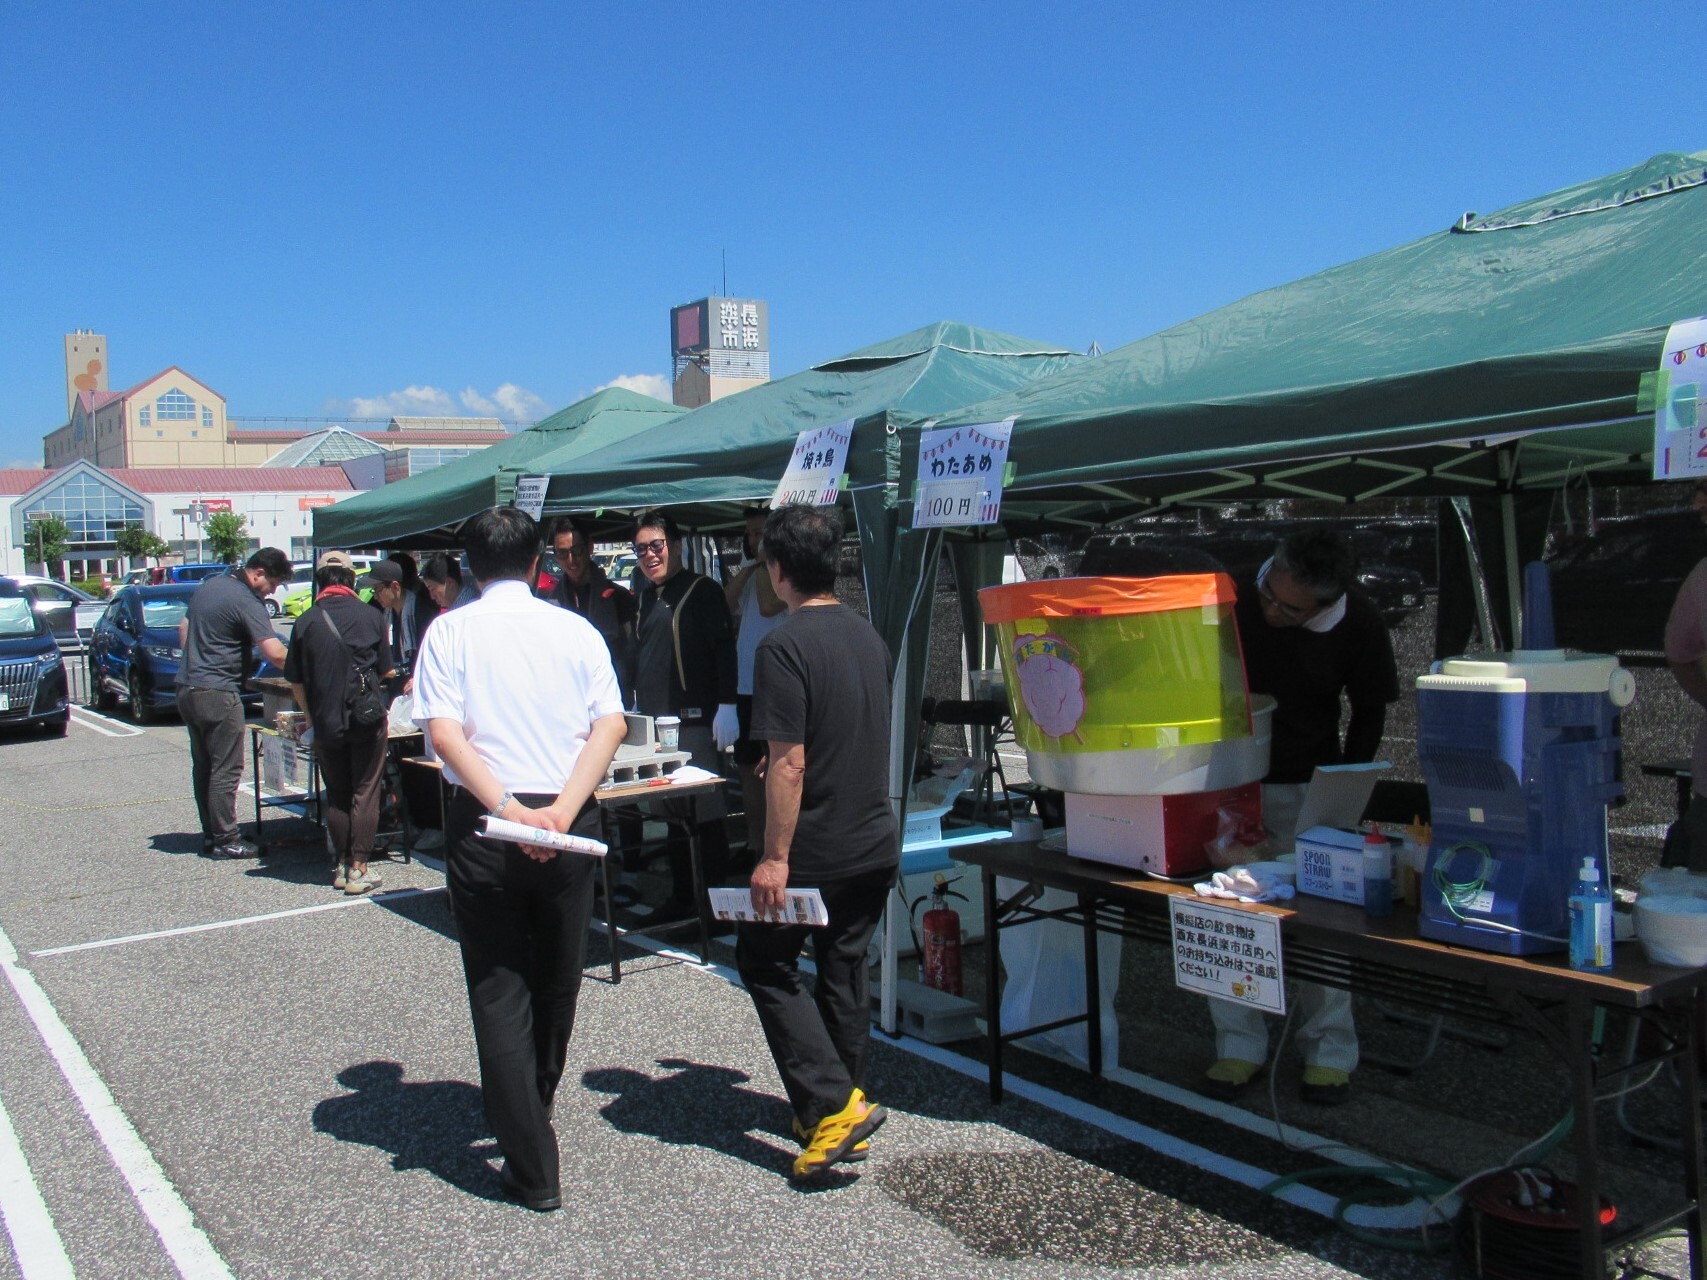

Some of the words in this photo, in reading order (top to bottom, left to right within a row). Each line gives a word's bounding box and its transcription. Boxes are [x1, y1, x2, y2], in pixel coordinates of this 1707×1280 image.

[720, 302, 739, 348] 楽市
[741, 304, 759, 349] 長浜
[802, 447, 834, 470] 焼き鳥
[931, 454, 992, 477] わたあめ
[779, 489, 805, 506] 200
[926, 497, 953, 517] 100
[958, 497, 971, 517] 円
[197, 512, 203, 521] D
[1303, 850, 1331, 865] SPOON
[1304, 863, 1331, 878] STRAW
[1175, 912, 1256, 939] 模擬店の飲食物は
[1176, 928, 1277, 961] 西友長浜楽市店内へ
[1177, 945, 1277, 979] のお持ち込みはご遠慮
